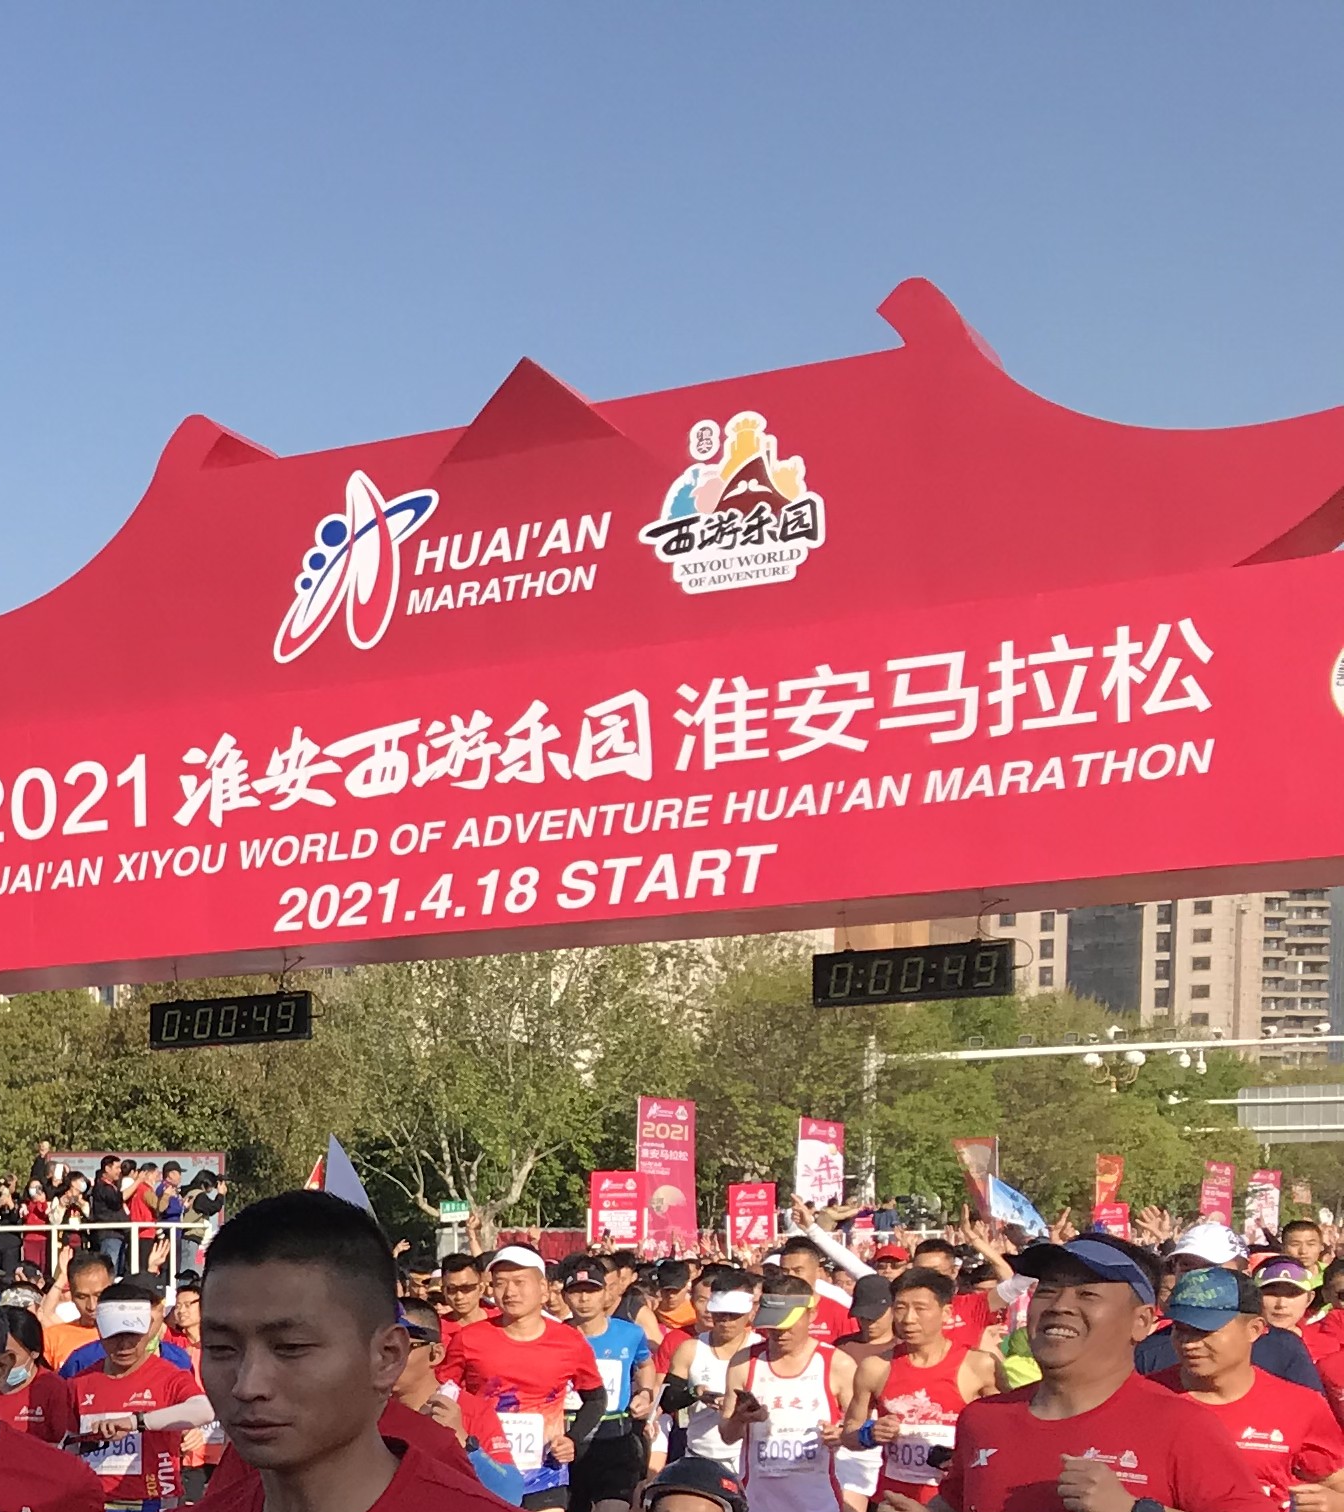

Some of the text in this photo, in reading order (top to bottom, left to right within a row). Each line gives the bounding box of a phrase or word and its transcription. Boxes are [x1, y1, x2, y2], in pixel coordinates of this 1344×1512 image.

[414, 511, 612, 575] HUAI'AN
[644, 500, 819, 557] 西游乐园
[679, 547, 802, 577] XIYOU WORLD
[688, 564, 790, 588] OF ADVENTURE
[406, 563, 597, 615] MARATHON
[173, 688, 653, 828] 淮安西游乐园
[674, 617, 1214, 772] 淮安马拉松
[114, 842, 229, 884] XIYOU
[240, 827, 378, 870] WORLD
[390, 820, 446, 857] OF
[452, 797, 711, 851] ADVENTURE
[723, 772, 912, 826] HUAI'AN
[922, 738, 1215, 804] MARATHON
[273, 843, 779, 933] 2021.4.18 START
[828, 950, 999, 999] 0:00:49
[161, 1001, 297, 1042] 0:00:49
[641, 1121, 689, 1141] 2021
